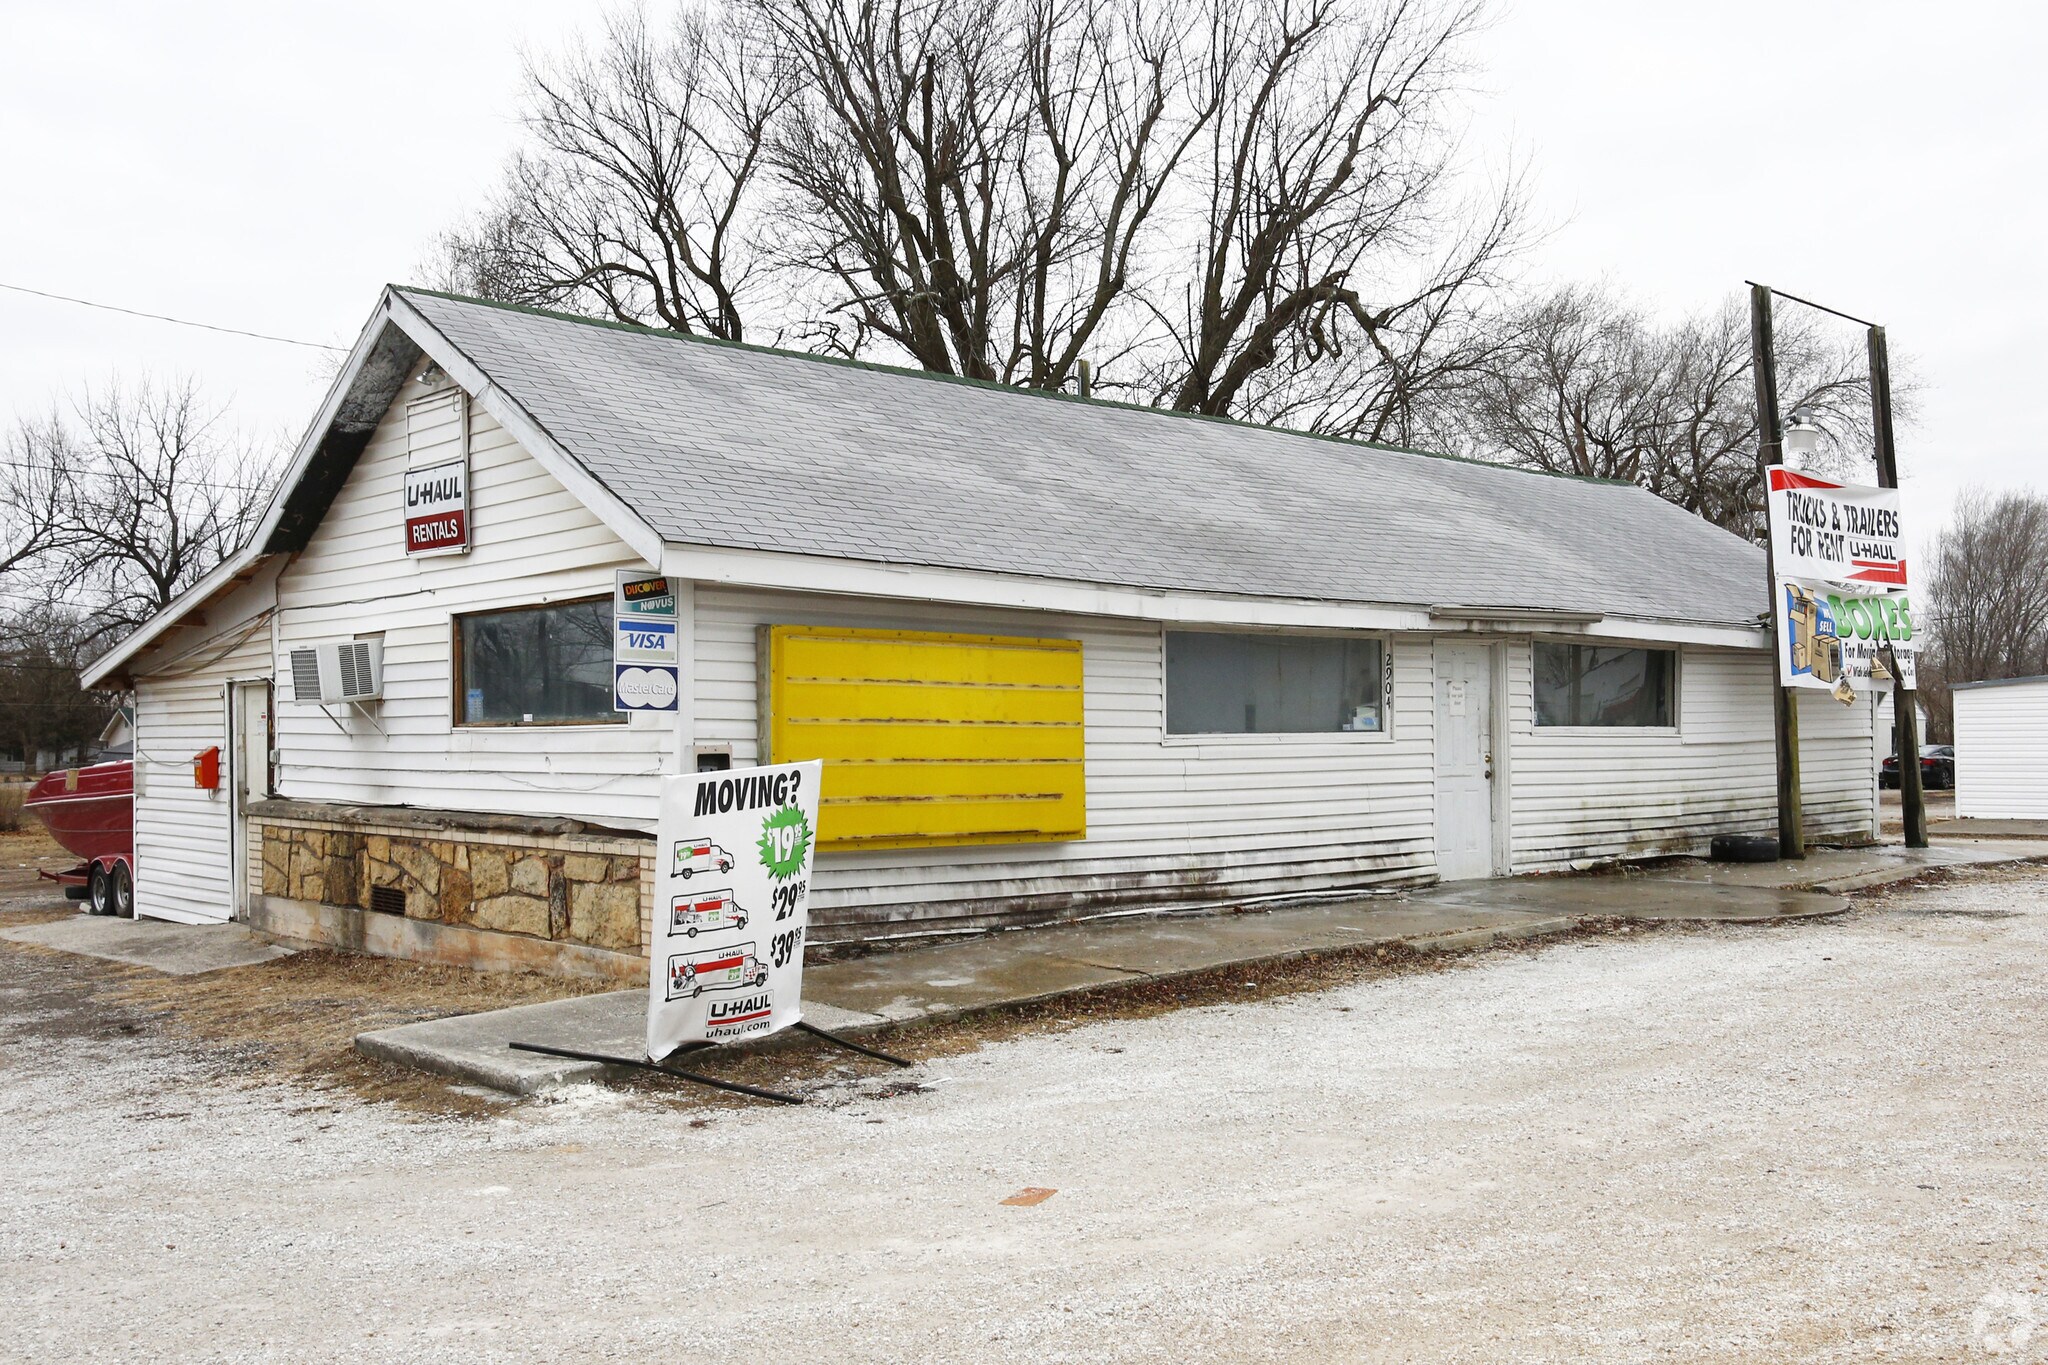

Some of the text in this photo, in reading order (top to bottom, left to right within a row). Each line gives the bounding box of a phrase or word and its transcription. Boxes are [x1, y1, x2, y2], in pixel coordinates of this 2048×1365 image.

[408, 477, 462, 507] U-HAUL
[1786, 490, 1899, 539] TRUCKS & TRAILERS
[412, 518, 459, 544] RENTALS
[1790, 525, 1897, 563] FOR RENT U-HAUL
[624, 580, 666, 596] DISCOVER
[640, 597, 674, 612] NOVUS
[1819, 620, 1833, 633] SELL
[1827, 594, 1913, 642] BOXES
[628, 632, 666, 650] VISA
[1844, 642, 1914, 664] For Movi torag
[618, 682, 674, 696] MasterCard
[694, 770, 801, 817] MOVING?
[718, 949, 744, 959] U-HAUL
[711, 994, 771, 1018] U-HAUL
[705, 1020, 770, 1039] uhaul.com
